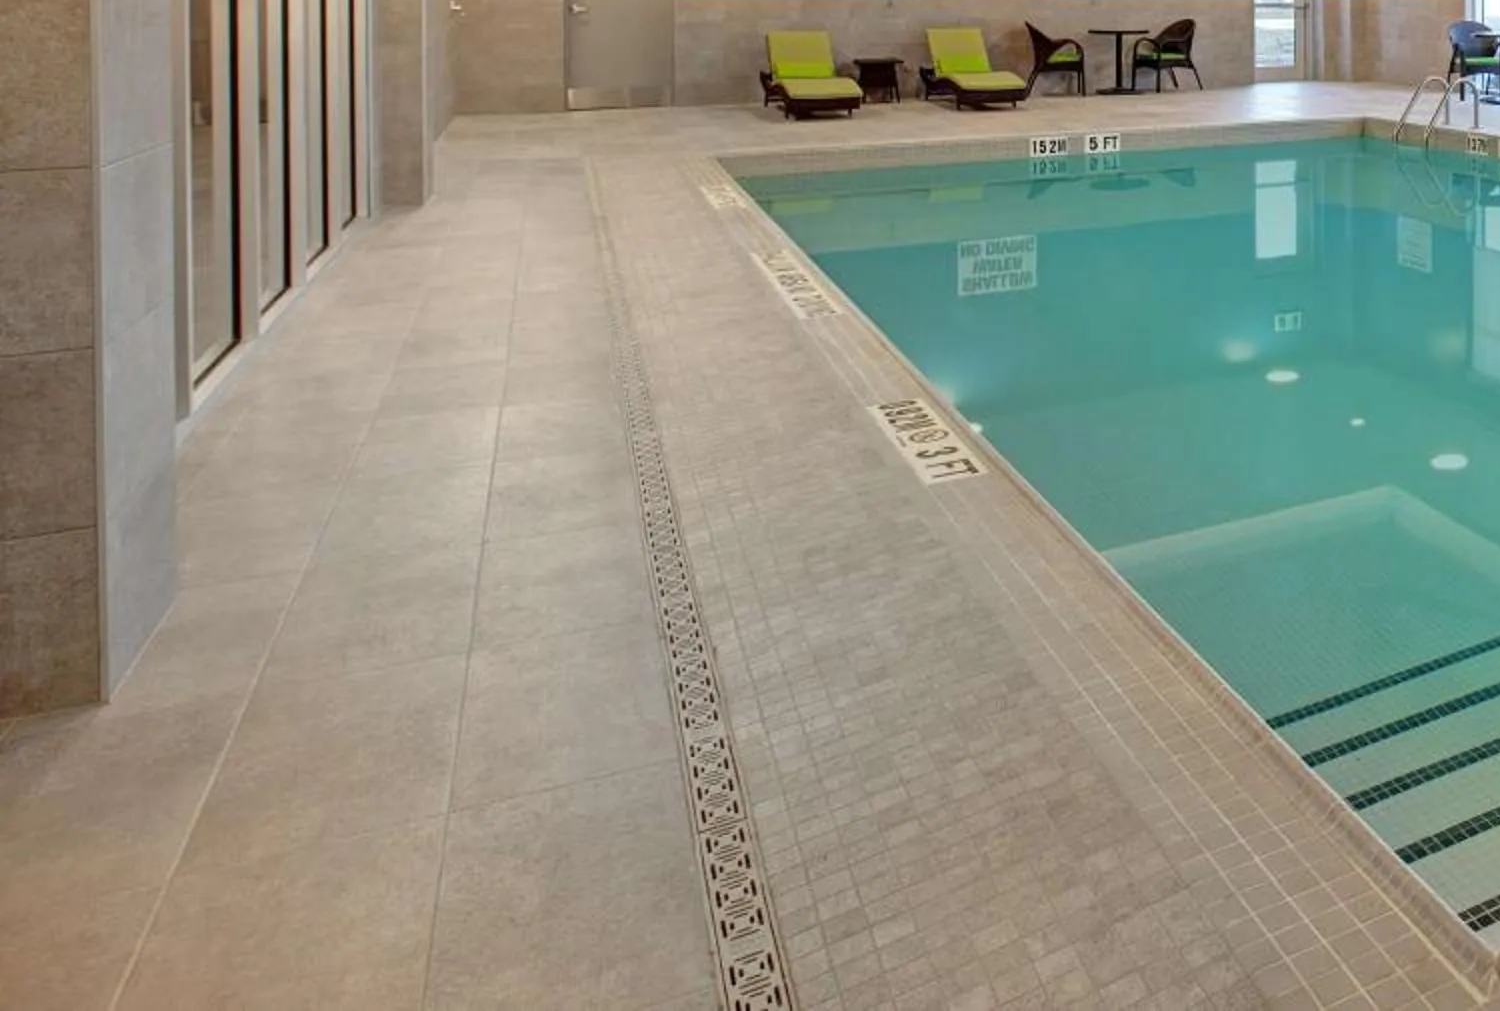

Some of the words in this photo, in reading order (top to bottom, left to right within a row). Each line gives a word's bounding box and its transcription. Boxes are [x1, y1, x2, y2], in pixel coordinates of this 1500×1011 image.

[1089, 136, 1099, 151] 5
[1103, 136, 1118, 150] FT
[915, 446, 958, 459] 3
[925, 457, 979, 479] FT
